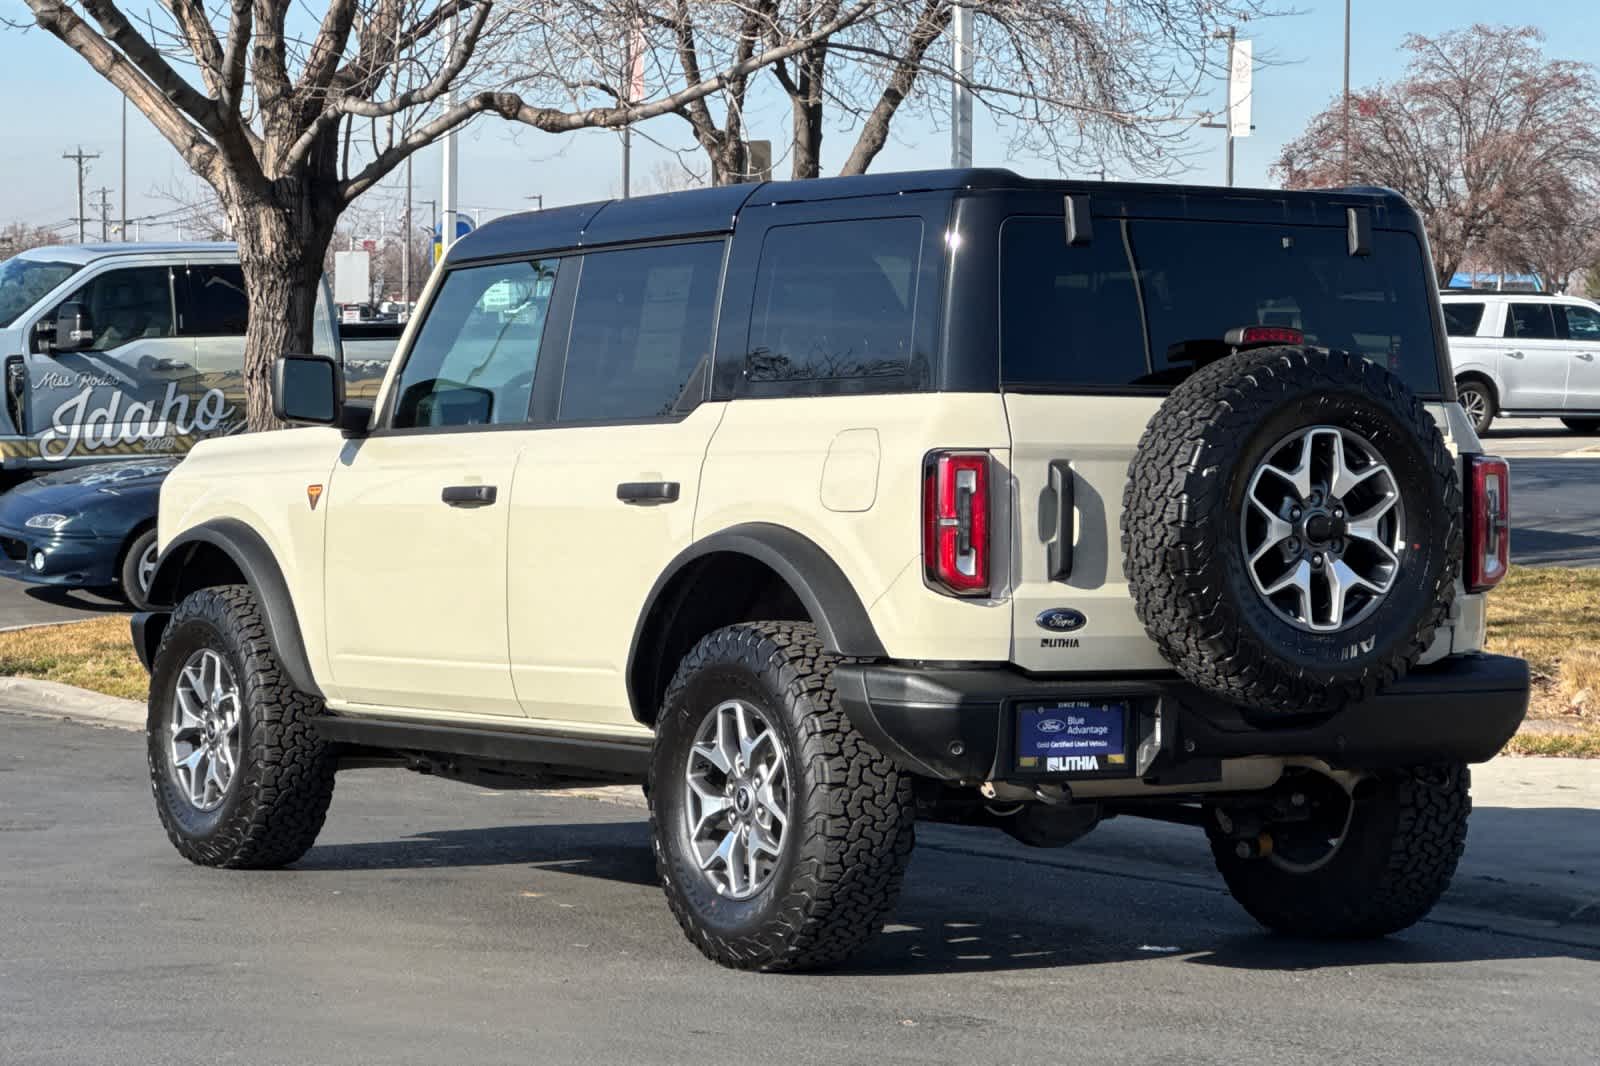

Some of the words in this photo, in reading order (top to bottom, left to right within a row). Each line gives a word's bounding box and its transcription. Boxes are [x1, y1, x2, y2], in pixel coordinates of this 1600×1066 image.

[32, 372, 72, 389] Miss
[39, 382, 236, 462] Idaho
[1049, 638, 1080, 648] LITHIA
[1067, 716, 1085, 725] Blue
[1067, 726, 1108, 736] Advantage
[1059, 755, 1099, 771] LITHIA
